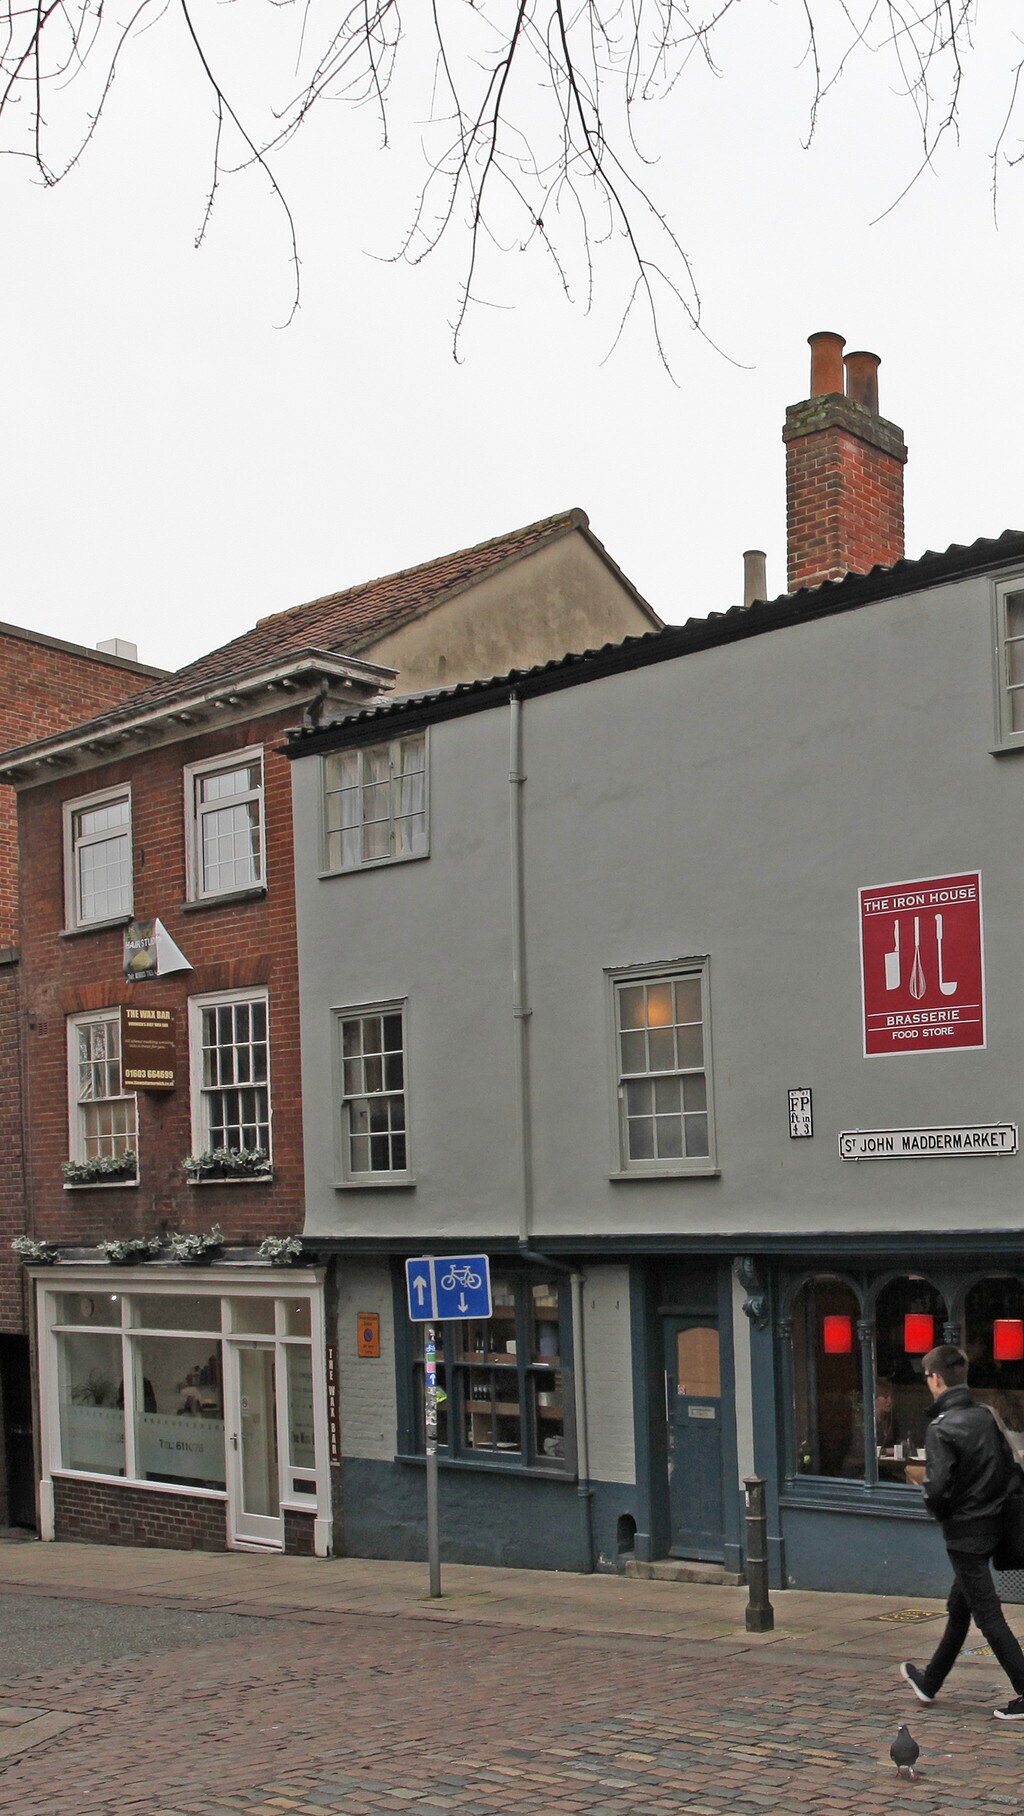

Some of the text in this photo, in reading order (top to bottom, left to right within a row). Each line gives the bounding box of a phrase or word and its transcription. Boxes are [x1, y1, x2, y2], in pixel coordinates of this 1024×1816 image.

[864, 887, 976, 912] THE IRON HOUSE
[126, 1009, 171, 1020] THE WAX BAR
[886, 1010, 960, 1026] BRASSERIE
[892, 1026, 954, 1040] FOOD STORE
[125, 1069, 146, 1078] 01603
[791, 1112, 800, 1123] ft
[793, 1123, 810, 1135] 4 3
[860, 1137, 894, 1152] JOHN
[902, 1132, 1007, 1150] MADDERMARKET
